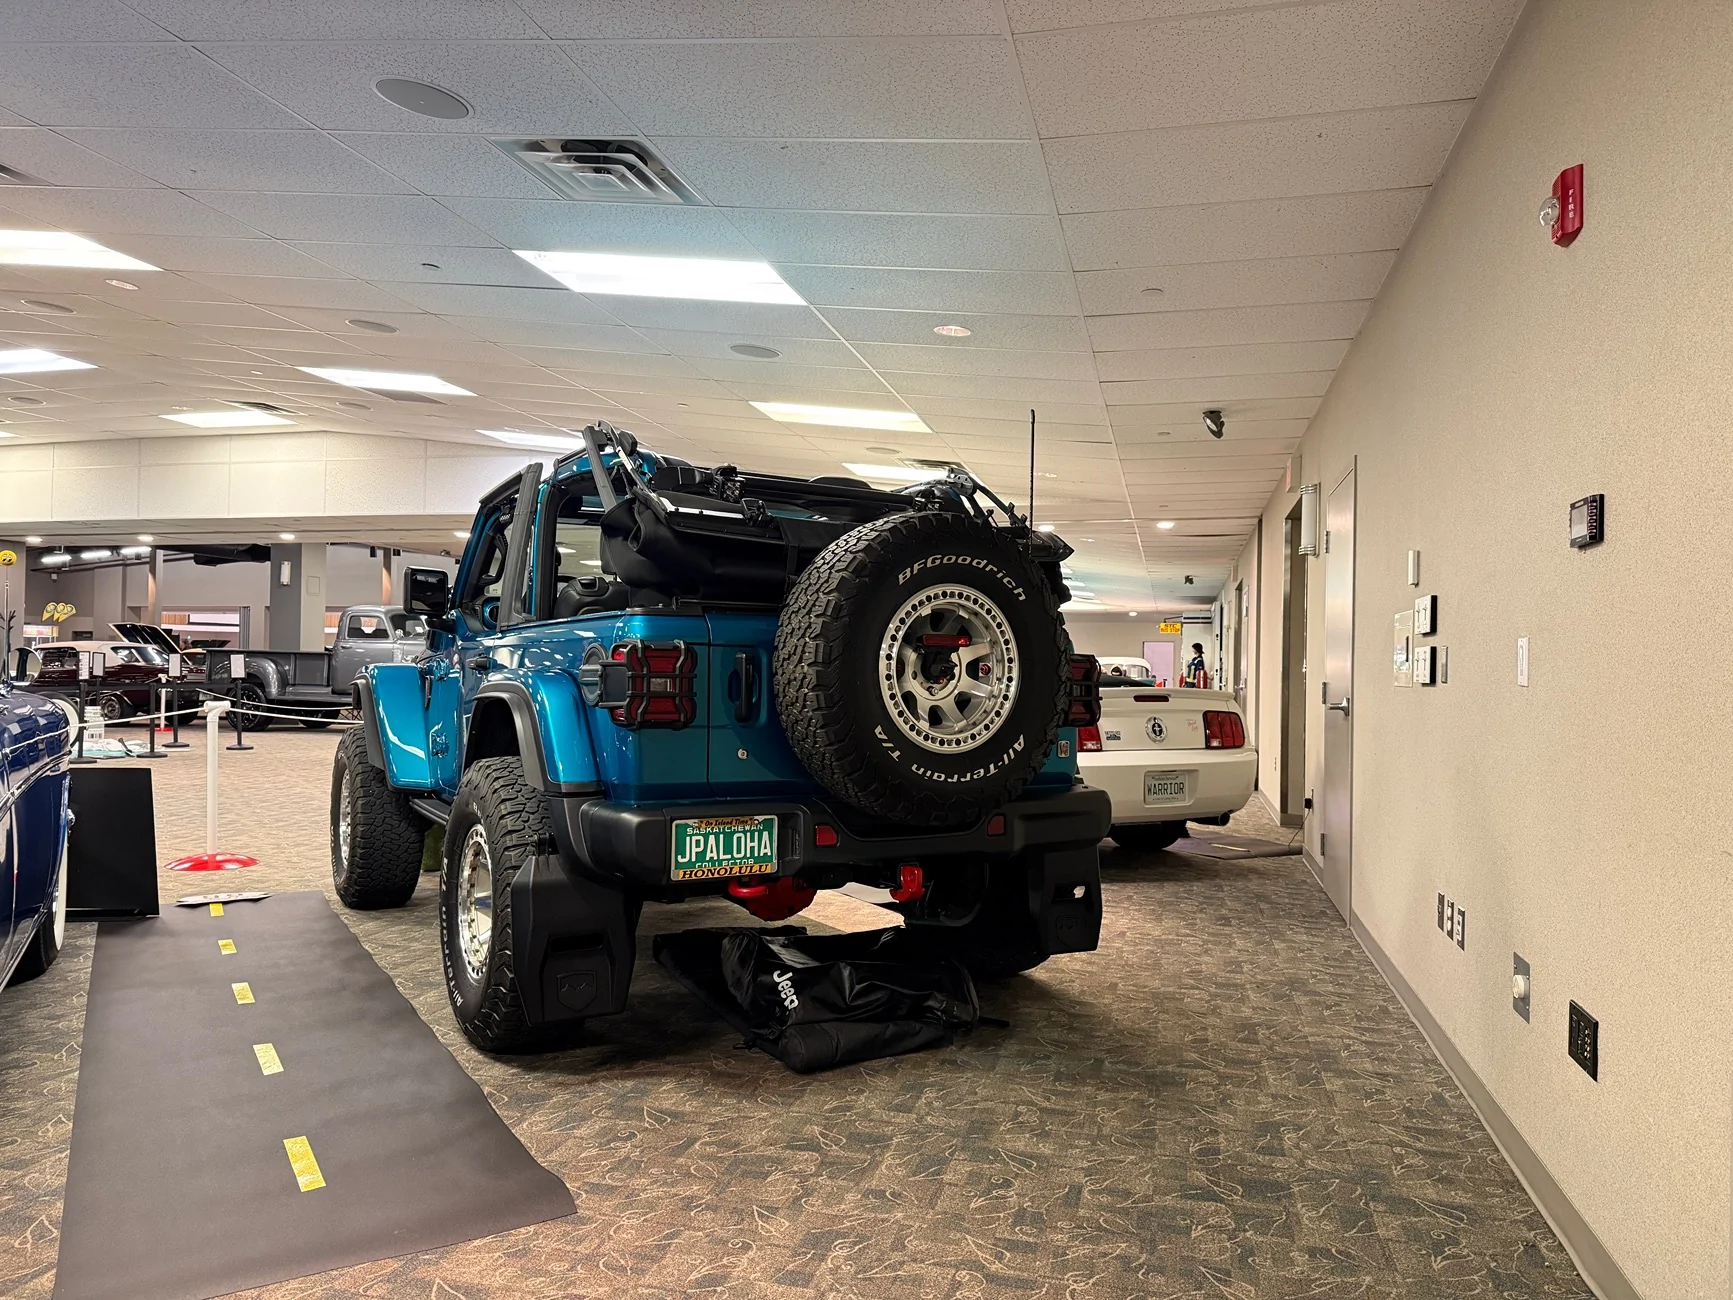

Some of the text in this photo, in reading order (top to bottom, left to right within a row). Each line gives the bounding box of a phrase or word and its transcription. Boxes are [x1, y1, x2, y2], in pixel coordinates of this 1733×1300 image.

[898, 554, 1027, 601] BFGoodrich
[874, 724, 1025, 783] All-Terrain T/A
[1146, 782, 1185, 796] WARRIOR
[687, 823, 763, 835] SASKATCHEWAN
[713, 818, 734, 826] Island
[734, 817, 749, 825] Time
[677, 831, 772, 863] JPALOHA
[681, 864, 769, 879] HONOLULU
[773, 970, 799, 1009] Jeep
